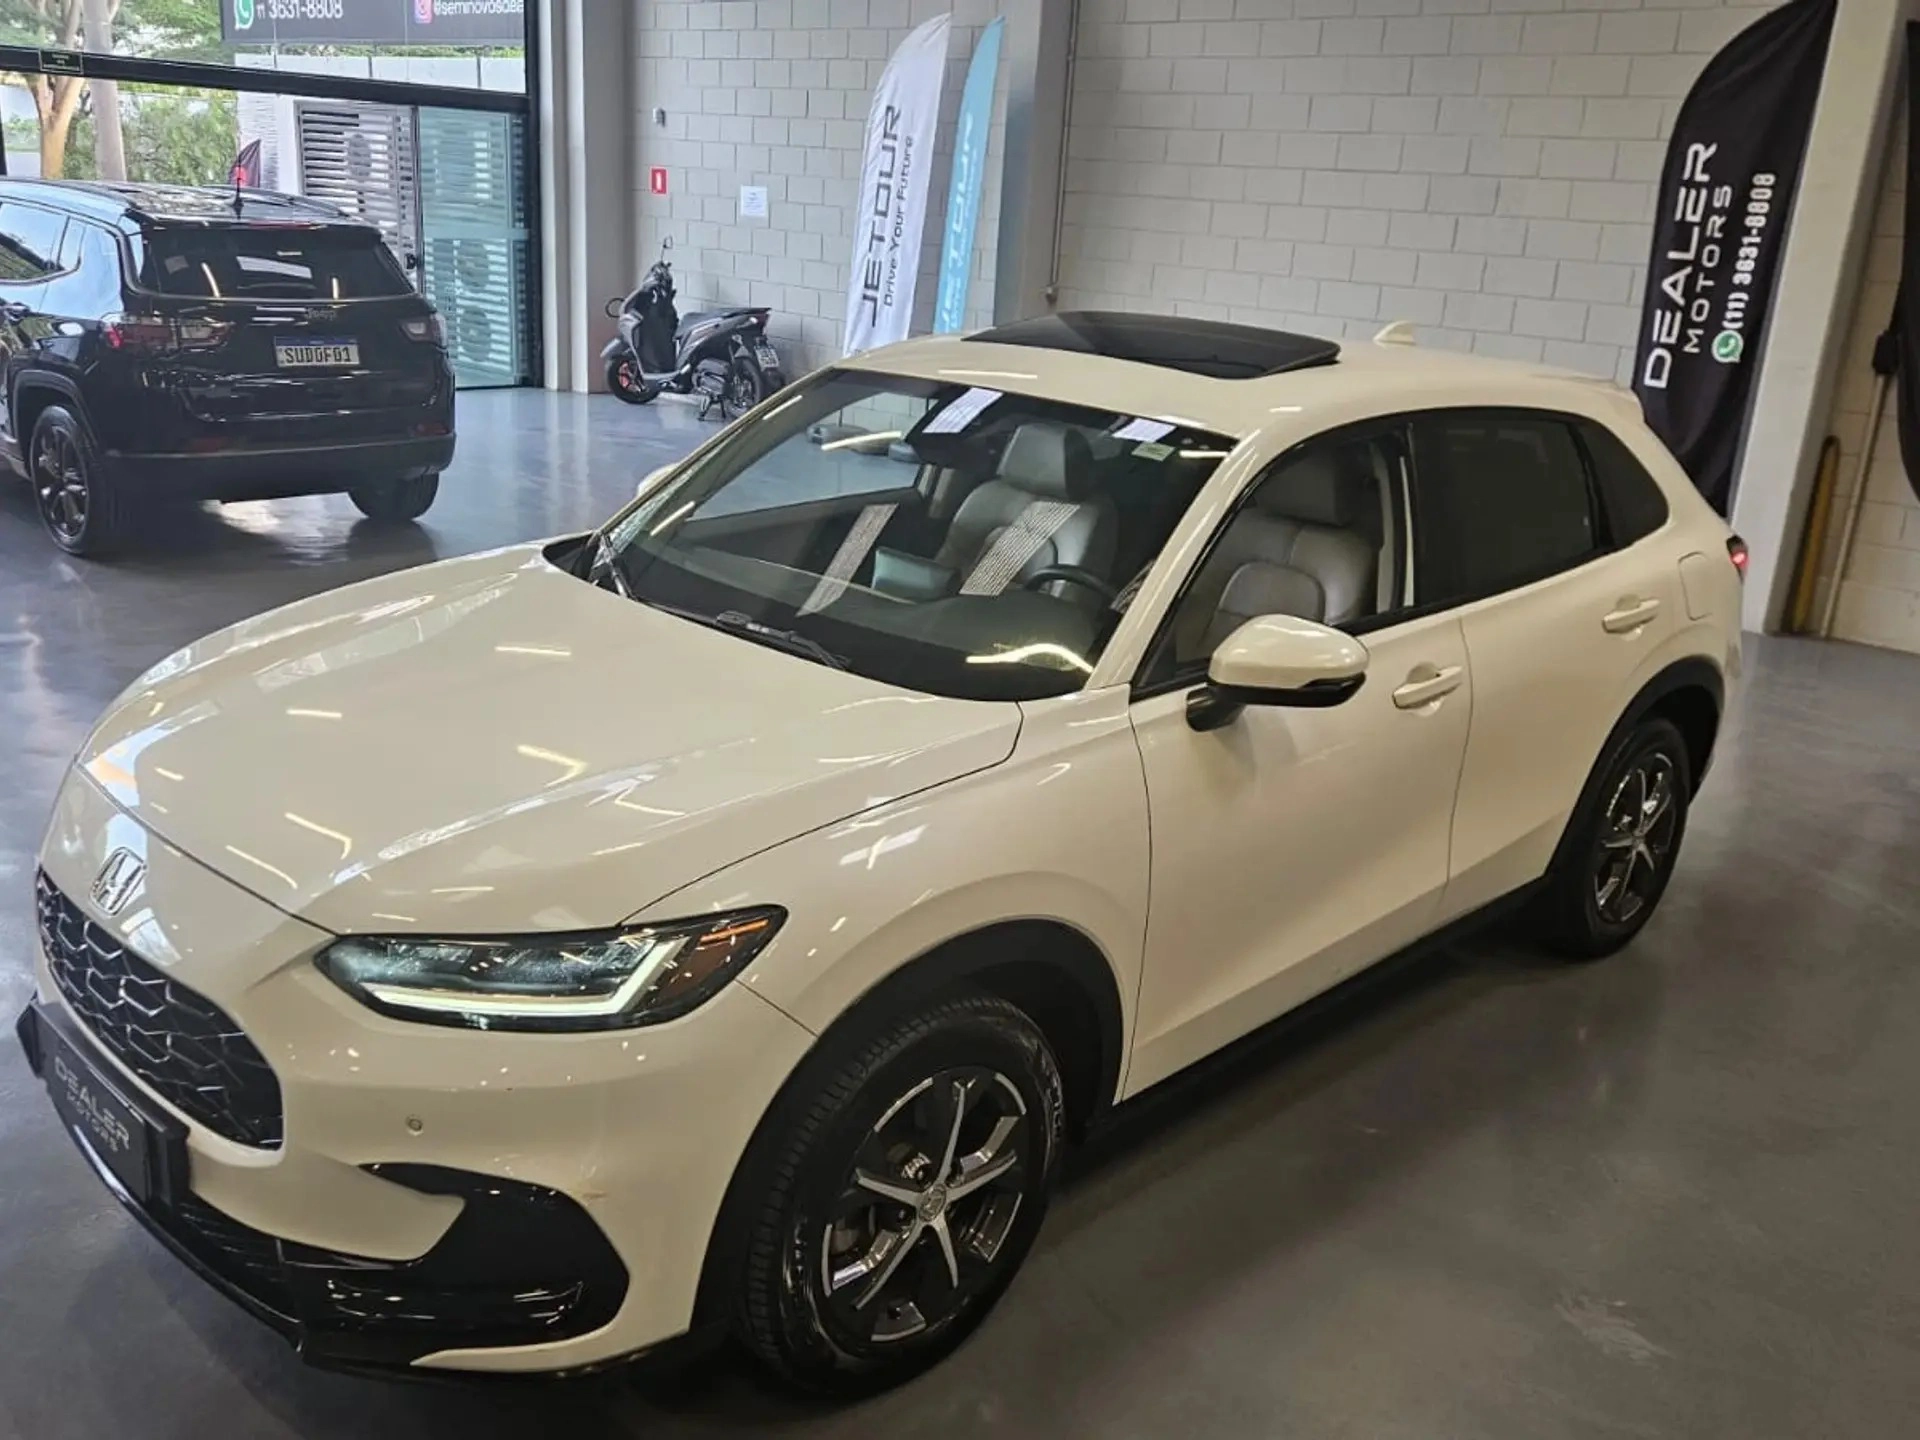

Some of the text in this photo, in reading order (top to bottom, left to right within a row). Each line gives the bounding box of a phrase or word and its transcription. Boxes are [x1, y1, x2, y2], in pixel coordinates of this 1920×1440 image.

[269, 0, 343, 19] 3631-8808
[860, 104, 902, 328] JETOUR
[884, 136, 913, 307] Drive Your Future
[1643, 142, 1718, 389] DEALER
[1683, 185, 1732, 353] MOTORS
[1722, 172, 1776, 329] (11) 3631-8808
[55, 1056, 129, 1150] DEALER
